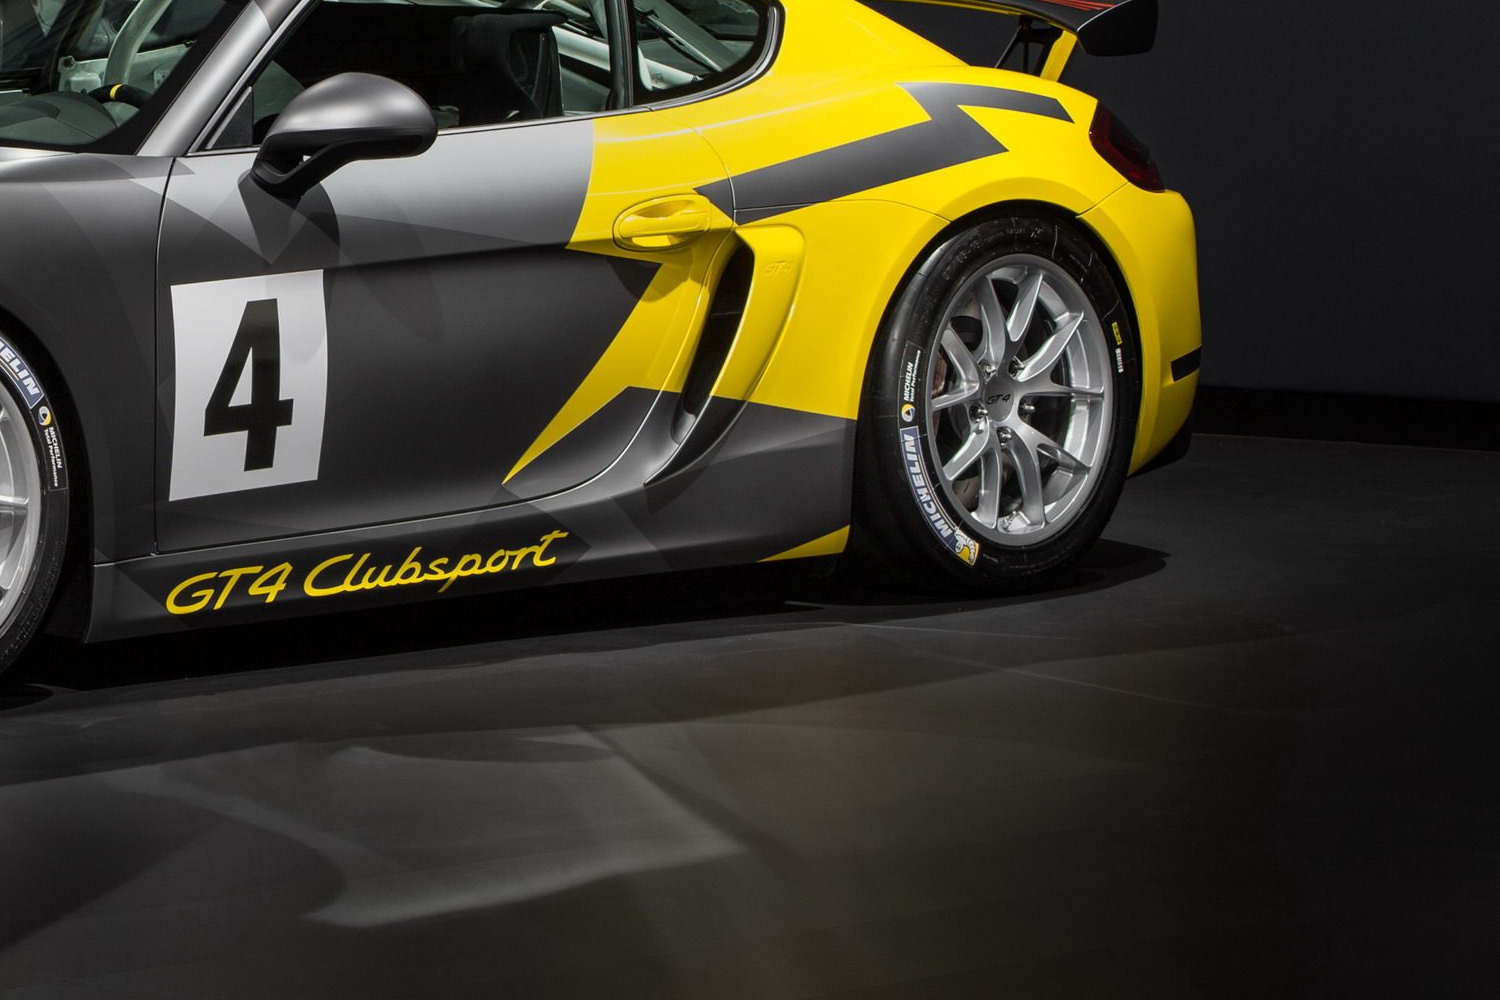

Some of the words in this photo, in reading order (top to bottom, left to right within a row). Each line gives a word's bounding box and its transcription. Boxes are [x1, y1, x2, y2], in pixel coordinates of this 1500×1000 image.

[203, 298, 294, 472] 4
[49, 427, 62, 469] MICHELIN
[903, 434, 953, 539] MICHELIN
[165, 562, 292, 615] GT4
[303, 530, 569, 597] Clubsport
